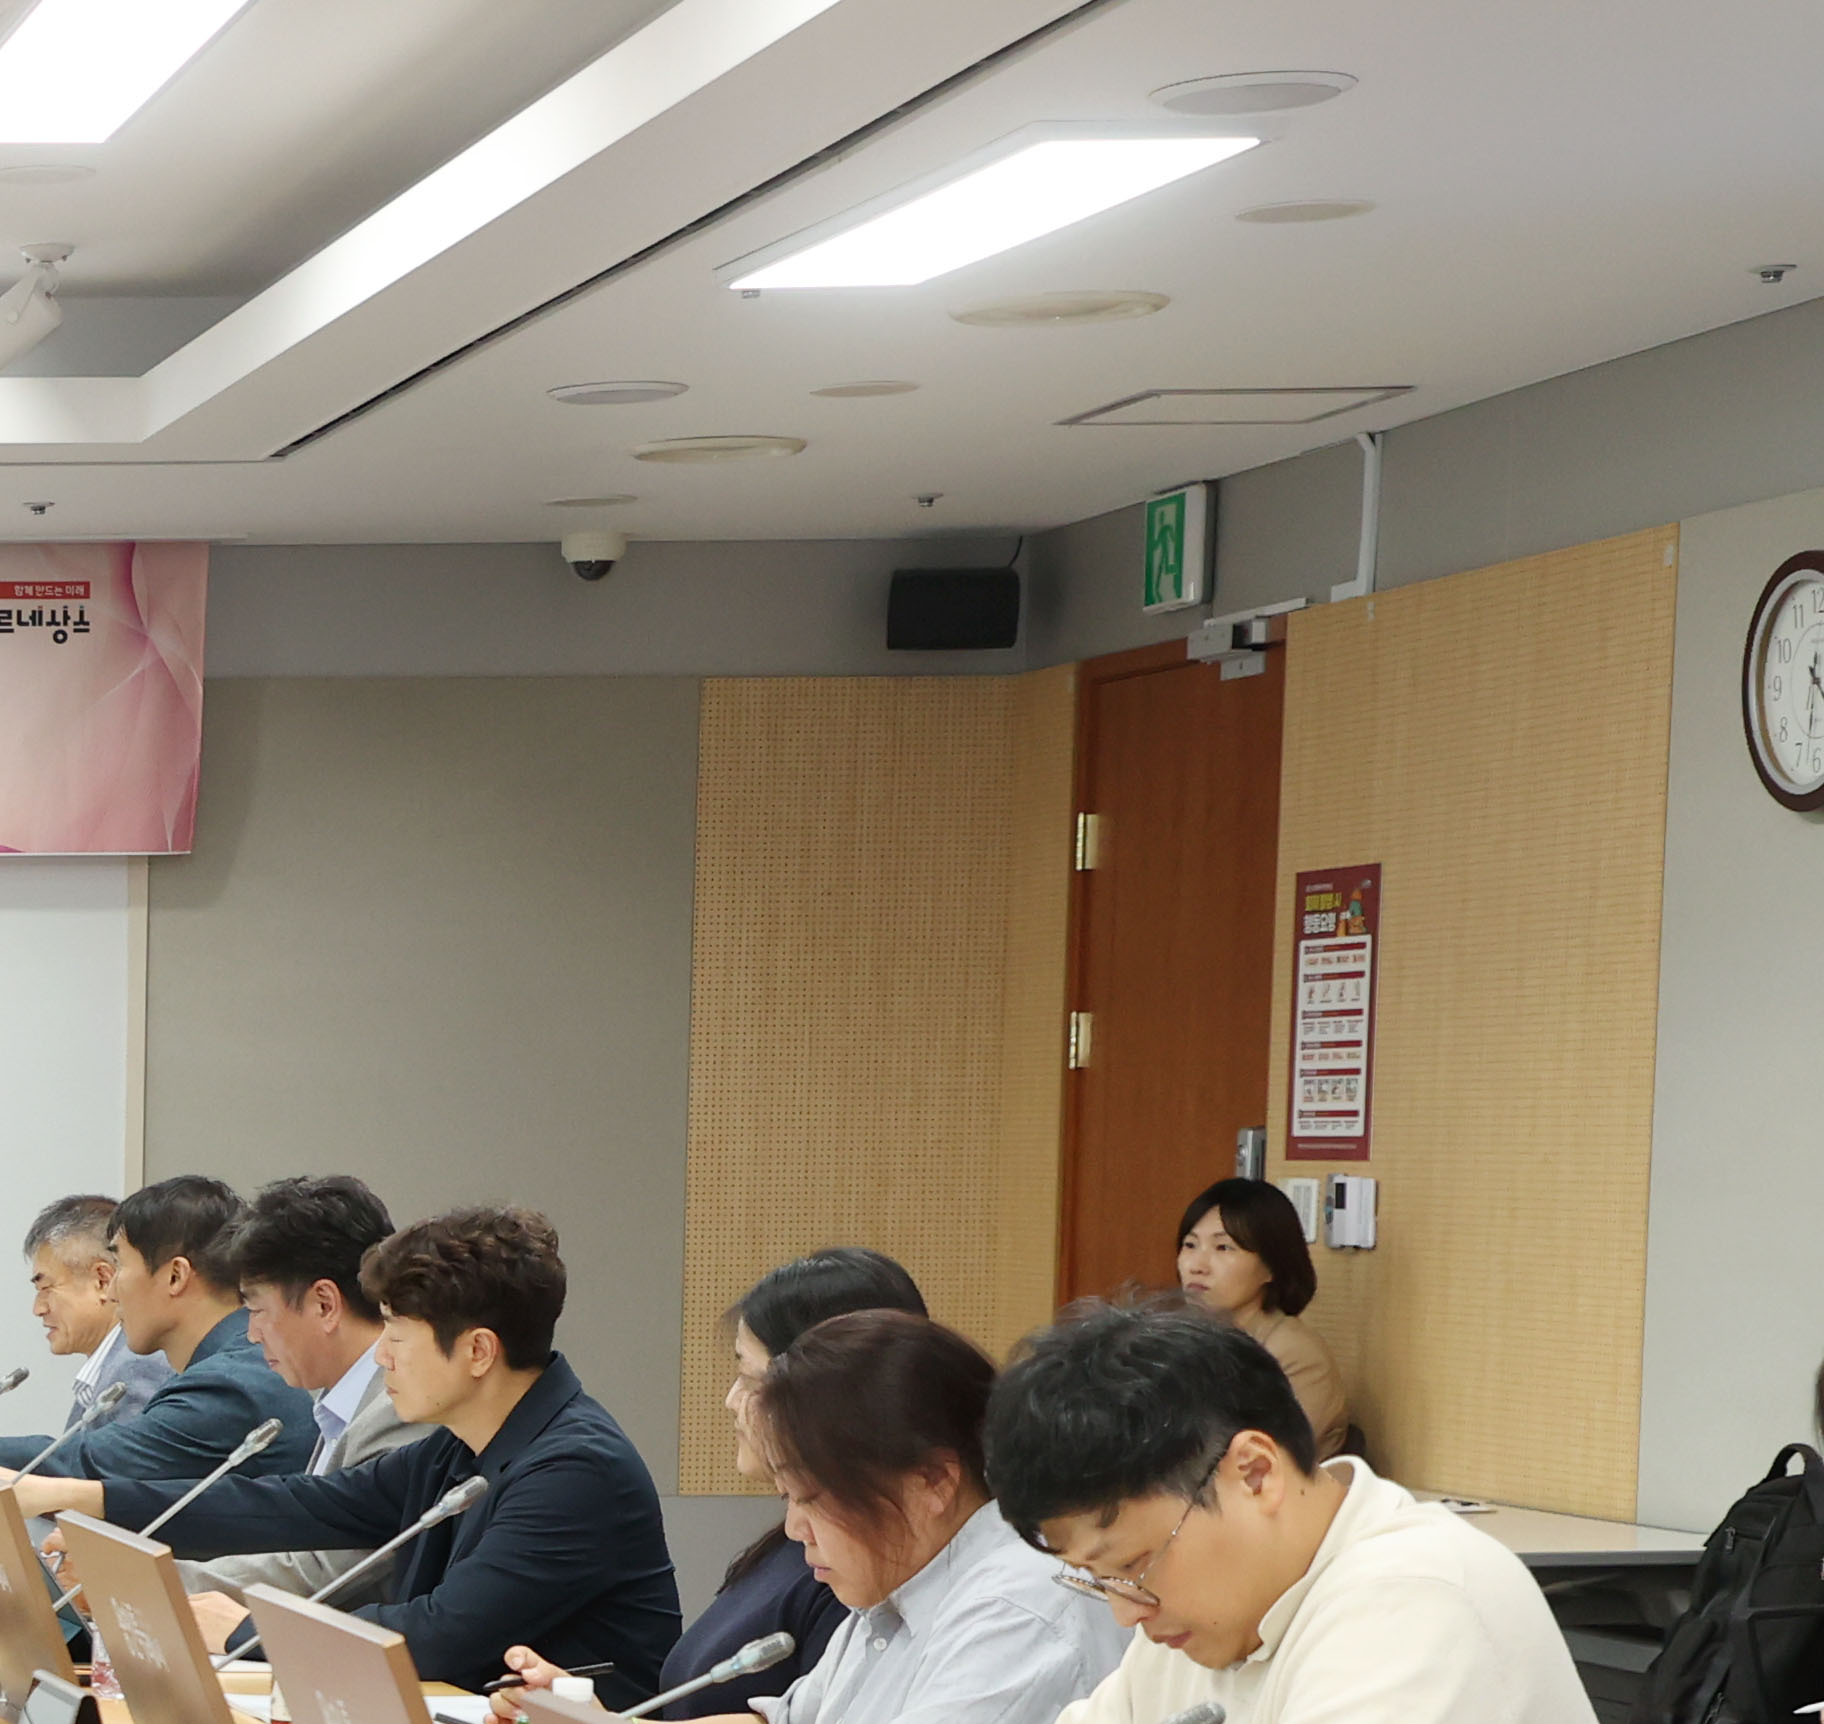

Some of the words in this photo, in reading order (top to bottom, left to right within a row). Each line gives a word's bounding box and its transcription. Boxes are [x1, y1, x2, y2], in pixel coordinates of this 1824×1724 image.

[14, 584, 34, 596] 함께
[35, 584, 63, 596] 만드는
[65, 584, 85, 596] 미래
[1792, 604, 1805, 629] 11
[1777, 638, 1792, 664] 10
[1773, 676, 1783, 701] 9
[1779, 717, 1789, 743] 8
[1795, 742, 1803, 768] 7
[1812, 747, 1822, 774] 6
